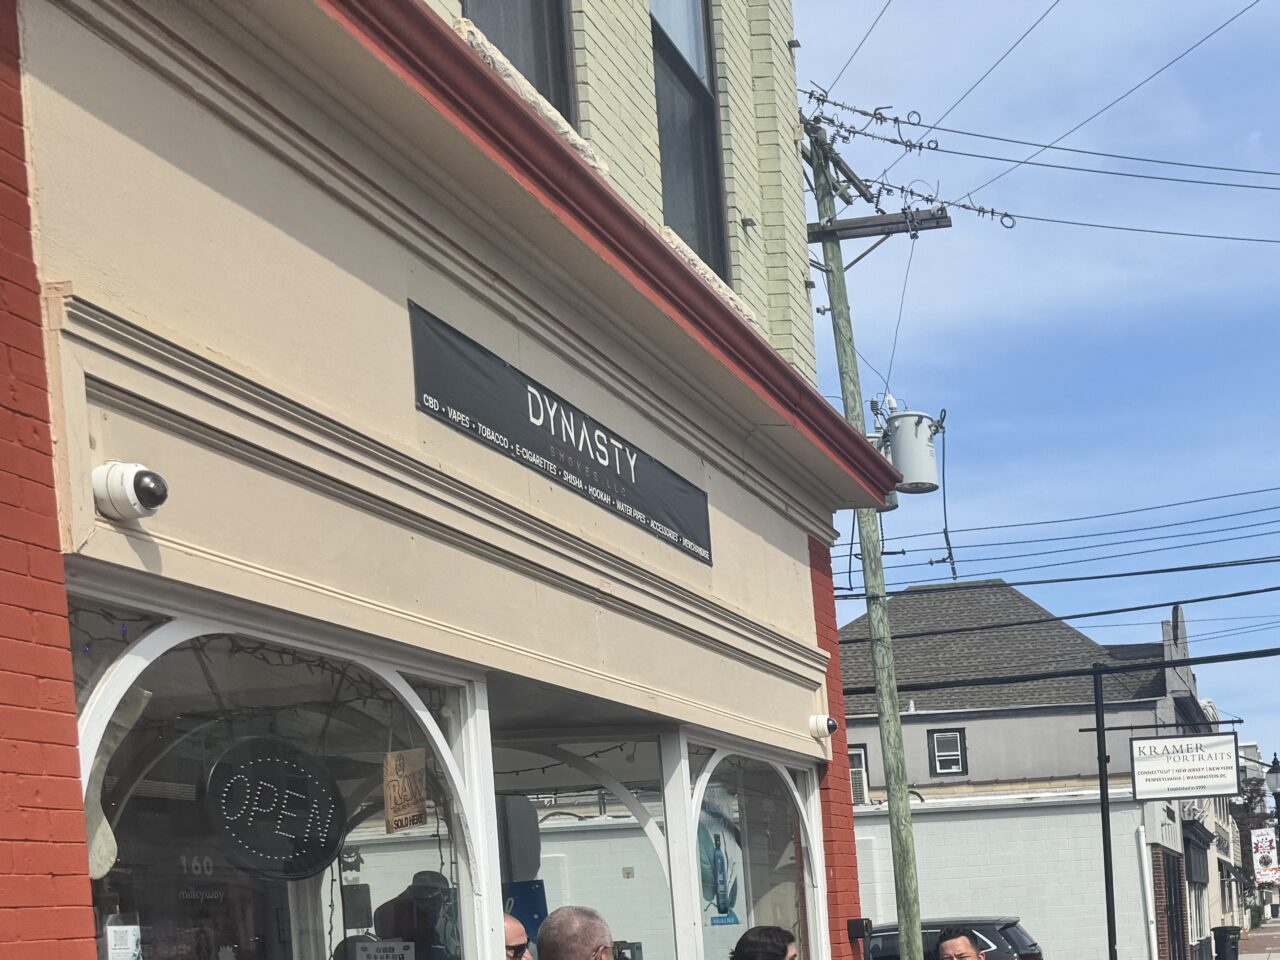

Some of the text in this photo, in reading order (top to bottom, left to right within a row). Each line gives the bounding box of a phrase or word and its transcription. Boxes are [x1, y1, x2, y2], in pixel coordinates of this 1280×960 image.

[527, 384, 637, 483] DYNASTY
[423, 393, 439, 411] CBD
[447, 406, 470, 428] VAPES
[477, 422, 509, 449] TOBACCO
[515, 444, 557, 475] E-CIGARETTES
[563, 470, 584, 490] SHISHA
[588, 484, 611, 504] HOOKAH
[616, 499, 632, 517] WATER
[632, 511, 646, 524] PIPES
[1138, 743, 1206, 757] KRAMER
[1166, 752, 1232, 763] PORTRAITS
[388, 768, 425, 809] RAW
[221, 774, 335, 847] OPEN
[393, 813, 424, 830] SOLD HERE
[180, 855, 214, 876] 160
